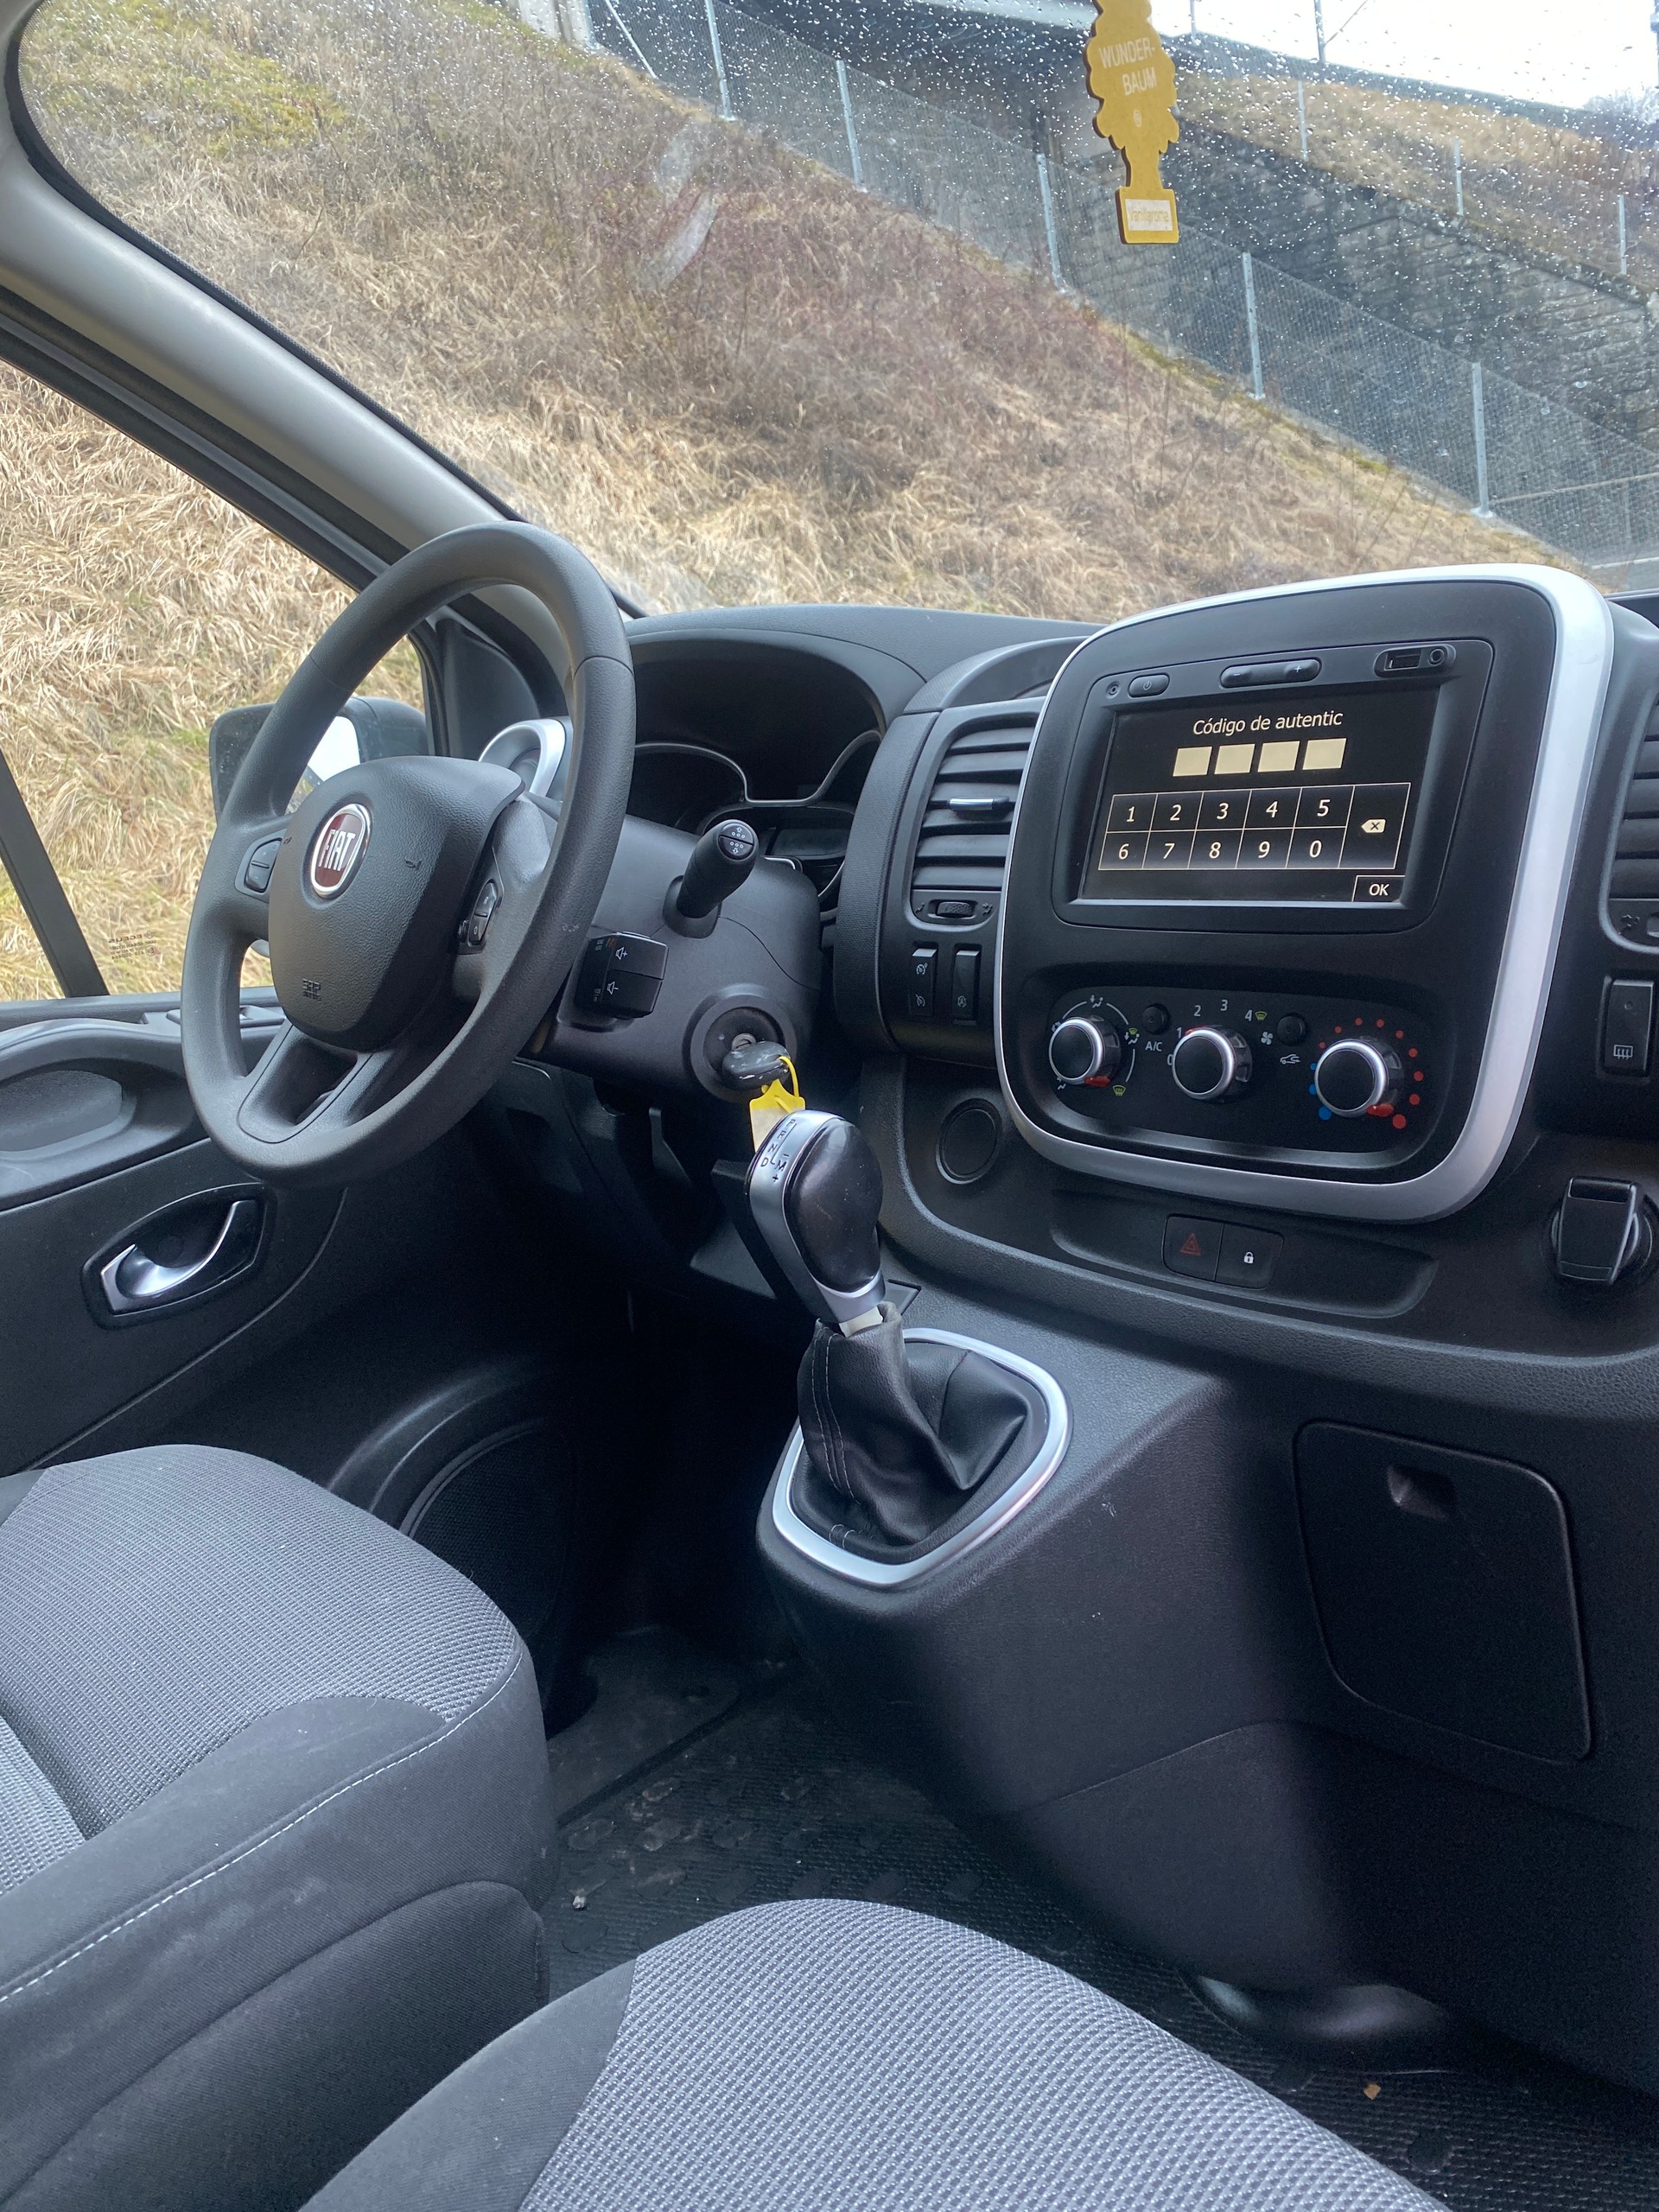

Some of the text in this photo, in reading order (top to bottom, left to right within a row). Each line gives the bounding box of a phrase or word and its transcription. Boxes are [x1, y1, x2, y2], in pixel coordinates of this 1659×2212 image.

[1099, 37, 1155, 69] WUNDER-
[1122, 67, 1157, 96] BAUM
[1192, 710, 1344, 736] Código de autentic
[1126, 798, 1331, 823] 1 2 3 4 5
[319, 829, 356, 872] FIAT
[1118, 840, 1322, 860] 6 7 8 9 0
[1369, 883, 1389, 896] OK
[1176, 1000, 1253, 1038] 1 2 3 4
[1145, 1041, 1163, 1052] A/C
[777, 1130, 786, 1139] R
[767, 1142, 778, 1153] N
[760, 1157, 787, 1172] D M
